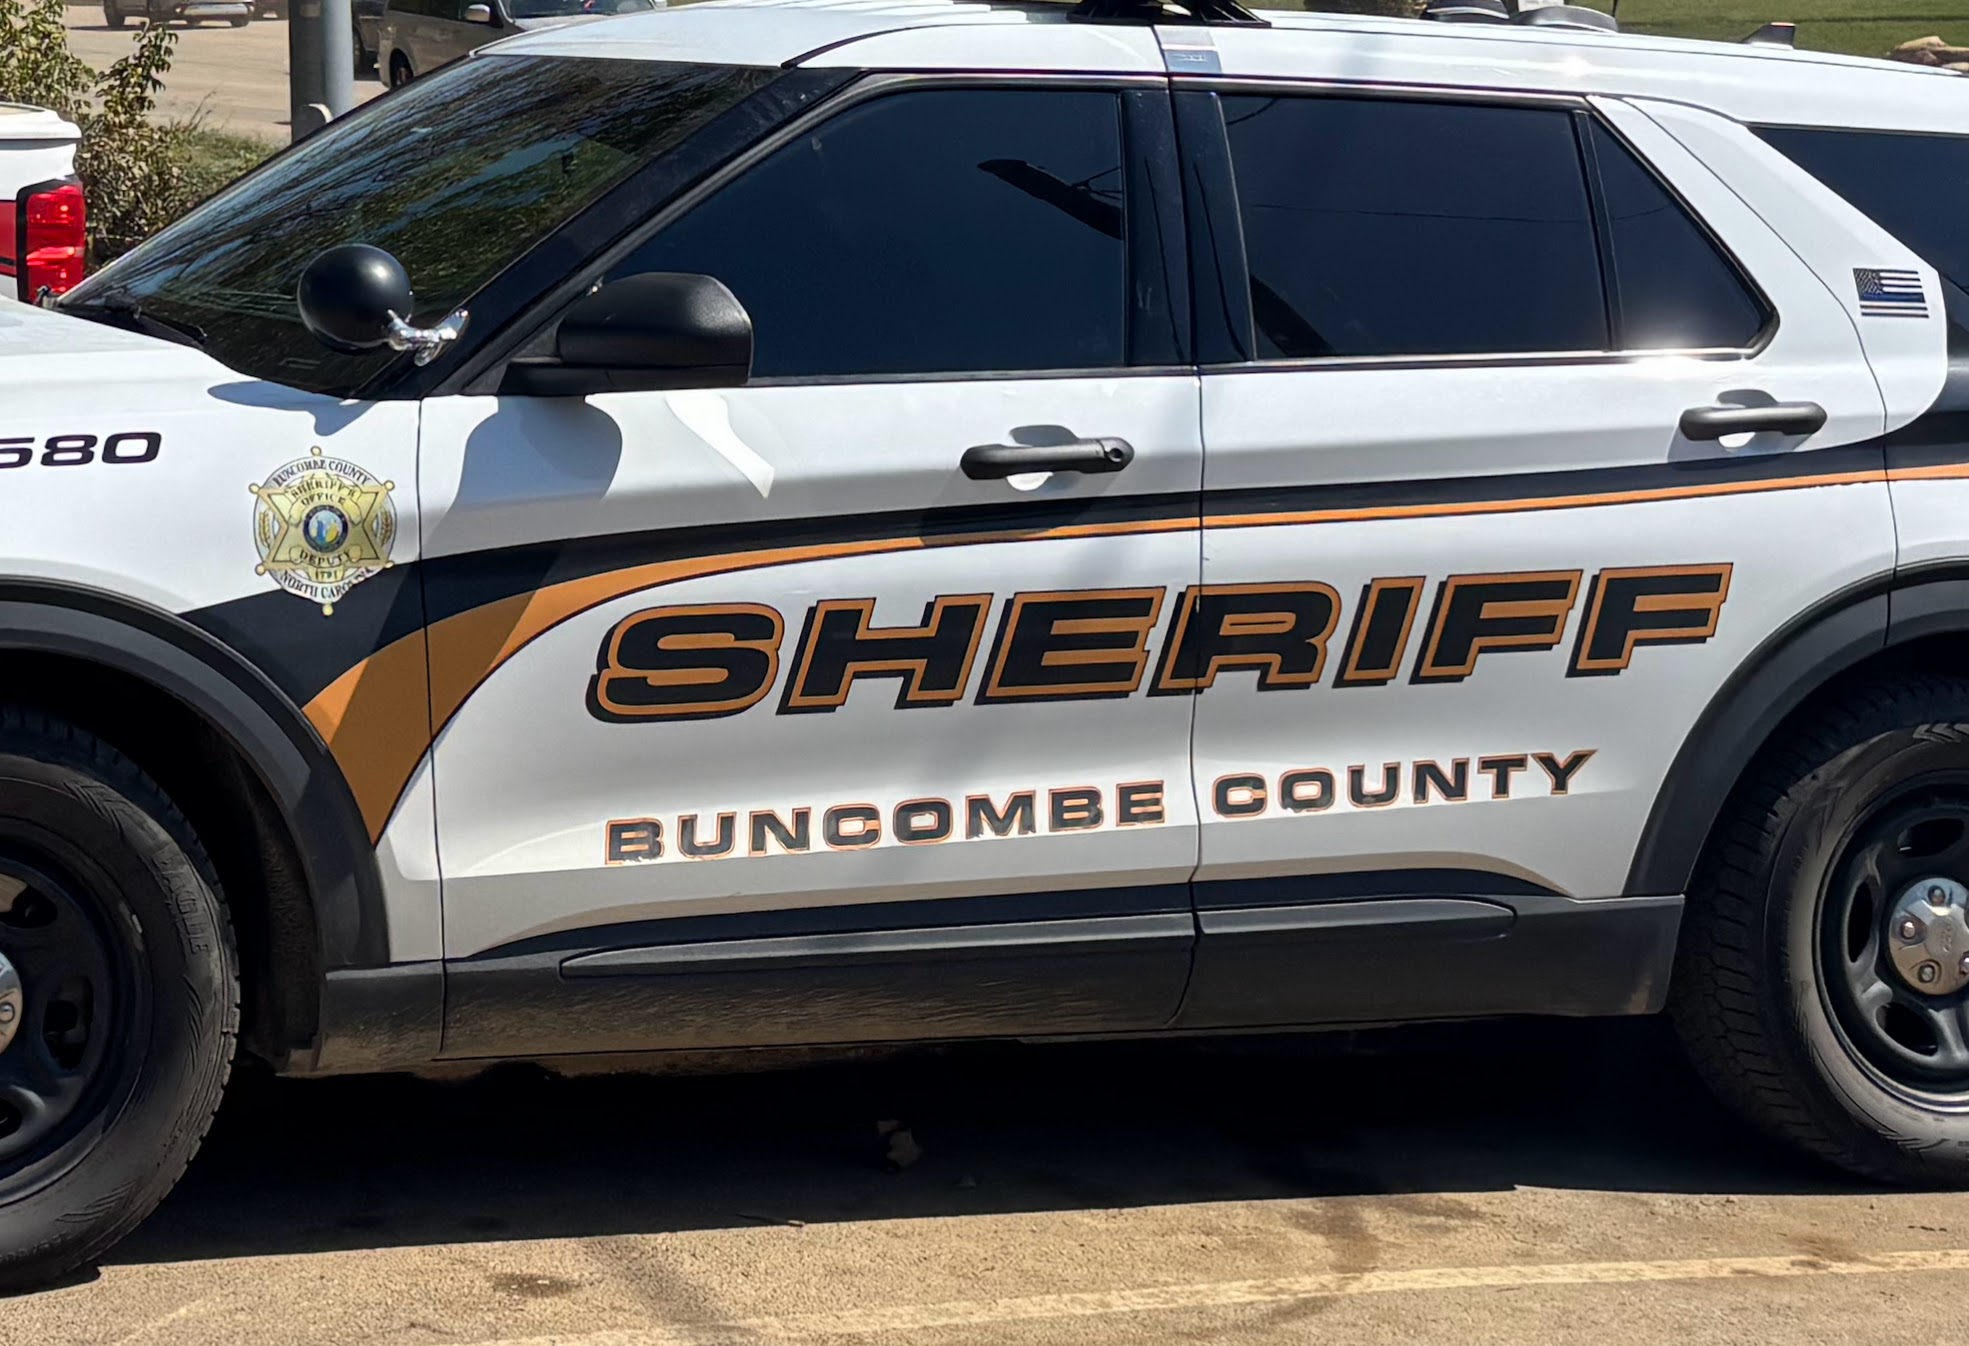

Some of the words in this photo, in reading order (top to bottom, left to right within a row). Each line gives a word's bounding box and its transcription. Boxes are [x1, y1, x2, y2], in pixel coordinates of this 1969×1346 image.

[272, 459, 327, 487] BUNCOMBE
[328, 460, 371, 485] COUNTY
[300, 549, 350, 566] DEPUTY
[281, 569, 319, 598] NORTH
[586, 562, 1733, 723] SHERIFF
[605, 780, 1165, 865] BUNCOMBE
[1212, 749, 1597, 818] COUNTY
